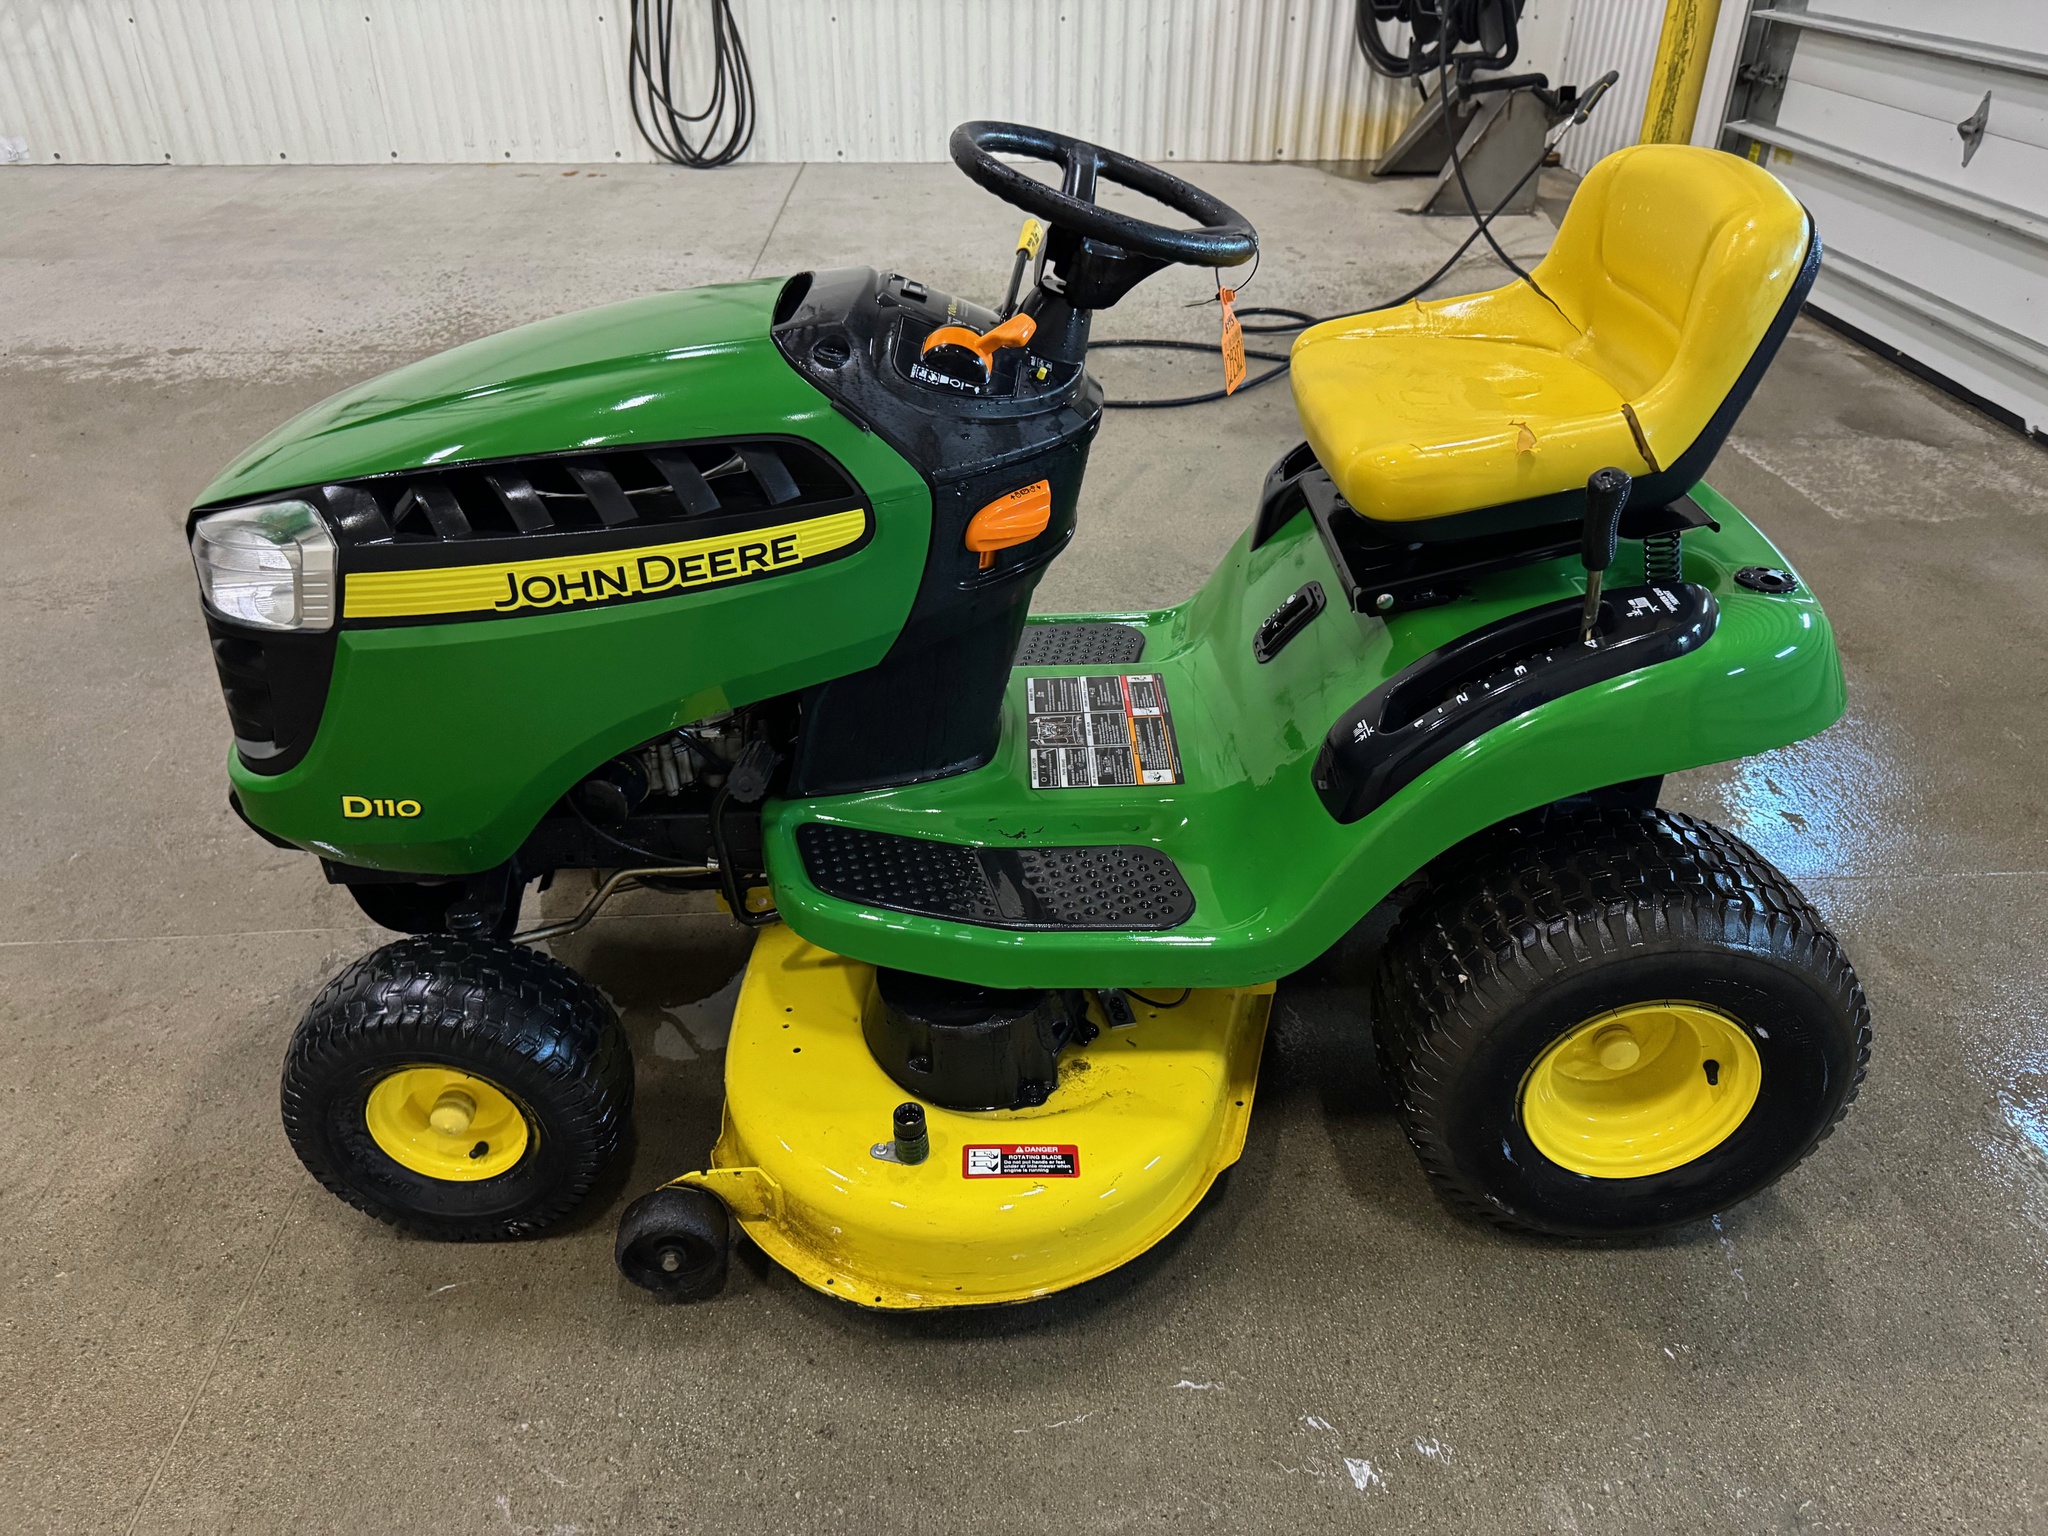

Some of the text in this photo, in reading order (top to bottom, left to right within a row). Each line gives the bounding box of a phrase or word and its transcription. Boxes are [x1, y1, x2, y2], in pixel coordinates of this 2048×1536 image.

[494, 533, 800, 608] JOHN DEERE
[1455, 692, 1469, 705] 2
[1514, 664, 1528, 677] 3
[341, 795, 422, 819] D110
